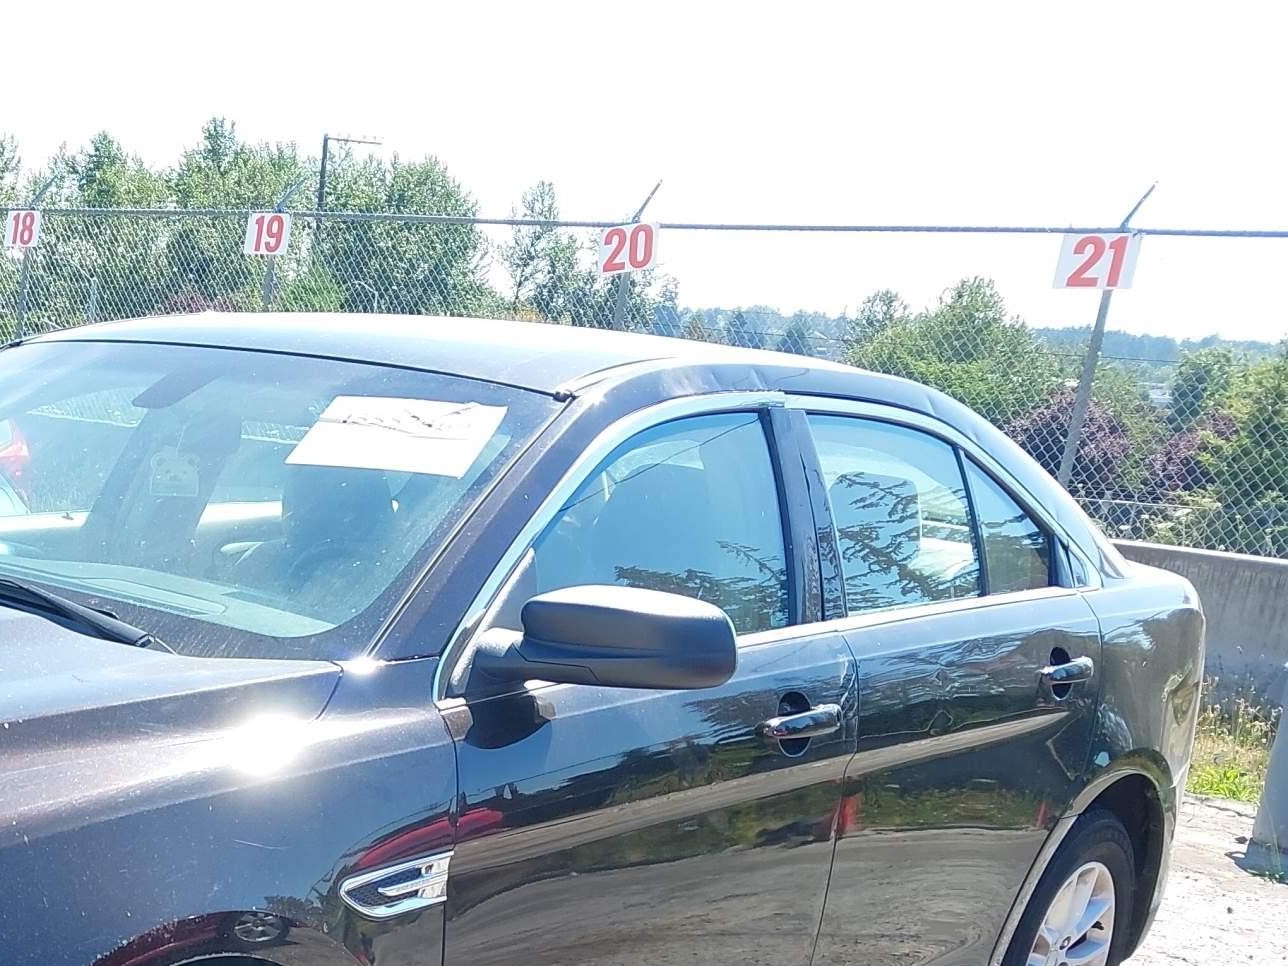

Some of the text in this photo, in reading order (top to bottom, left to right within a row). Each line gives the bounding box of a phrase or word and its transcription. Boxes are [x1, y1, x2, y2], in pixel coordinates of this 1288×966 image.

[11, 211, 35, 246] 18
[253, 214, 285, 253] 19
[602, 223, 654, 273] 20
[1065, 235, 1129, 288] 21
